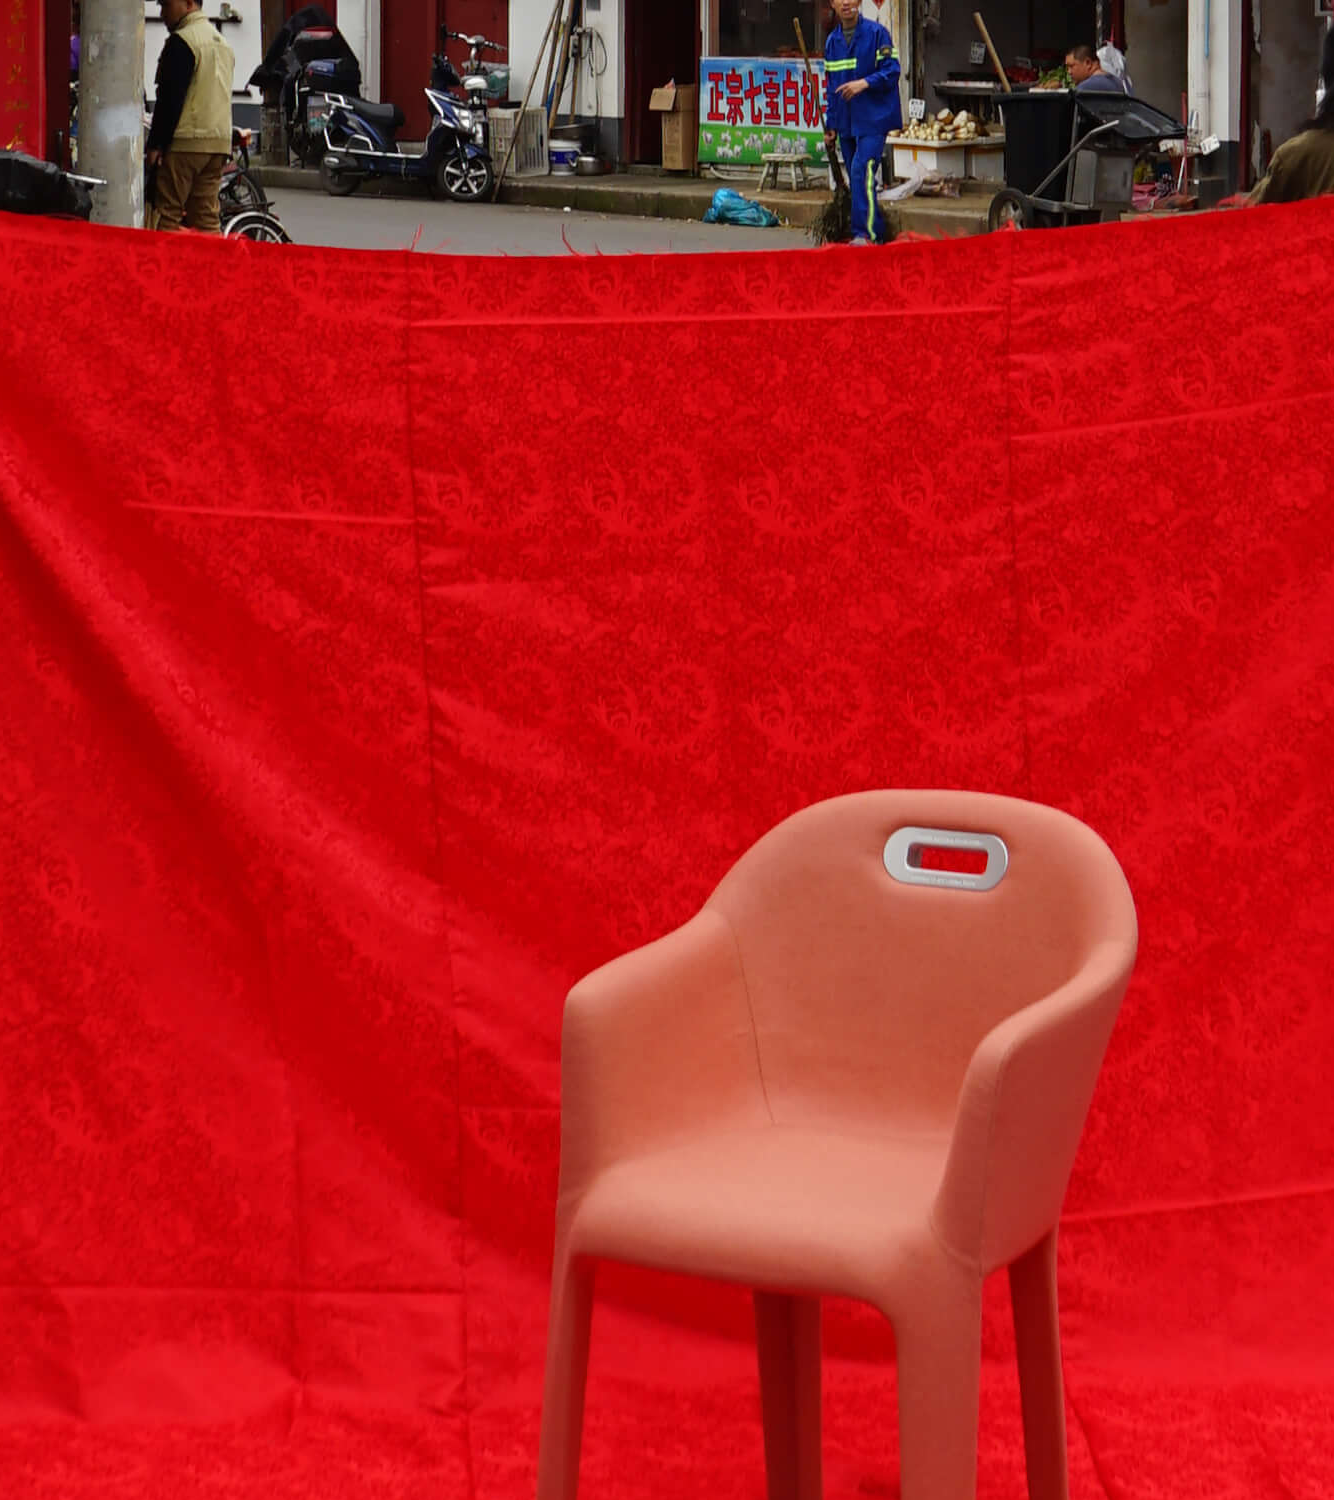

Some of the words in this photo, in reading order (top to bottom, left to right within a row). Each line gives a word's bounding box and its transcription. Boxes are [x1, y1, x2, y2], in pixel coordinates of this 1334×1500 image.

[707, 67, 827, 128] 正宗七宝白切
